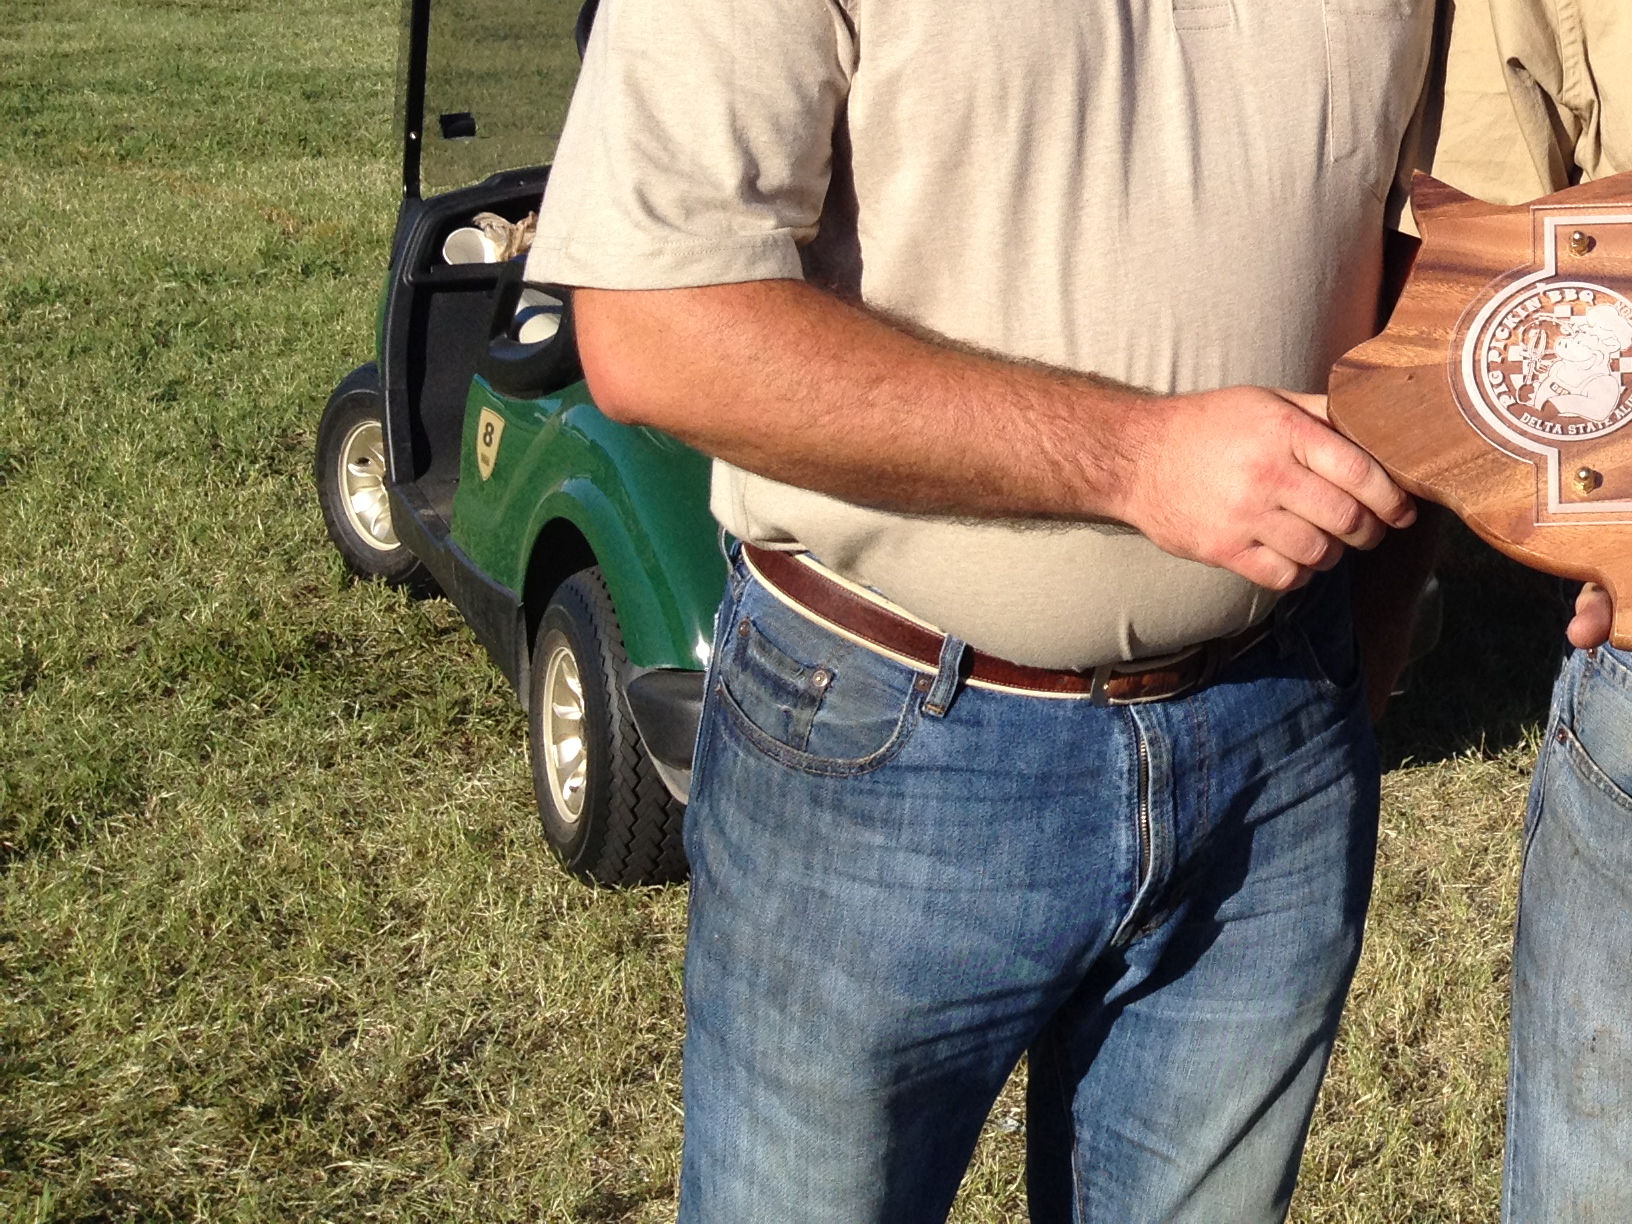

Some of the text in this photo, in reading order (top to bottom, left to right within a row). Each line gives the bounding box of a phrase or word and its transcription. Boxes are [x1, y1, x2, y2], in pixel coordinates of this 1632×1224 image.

[1488, 370, 1517, 409] PIG
[1546, 288, 1597, 306] BBQ
[483, 421, 495, 447] 8
[1520, 412, 1563, 435] DELTA
[1568, 417, 1612, 435] STATE
